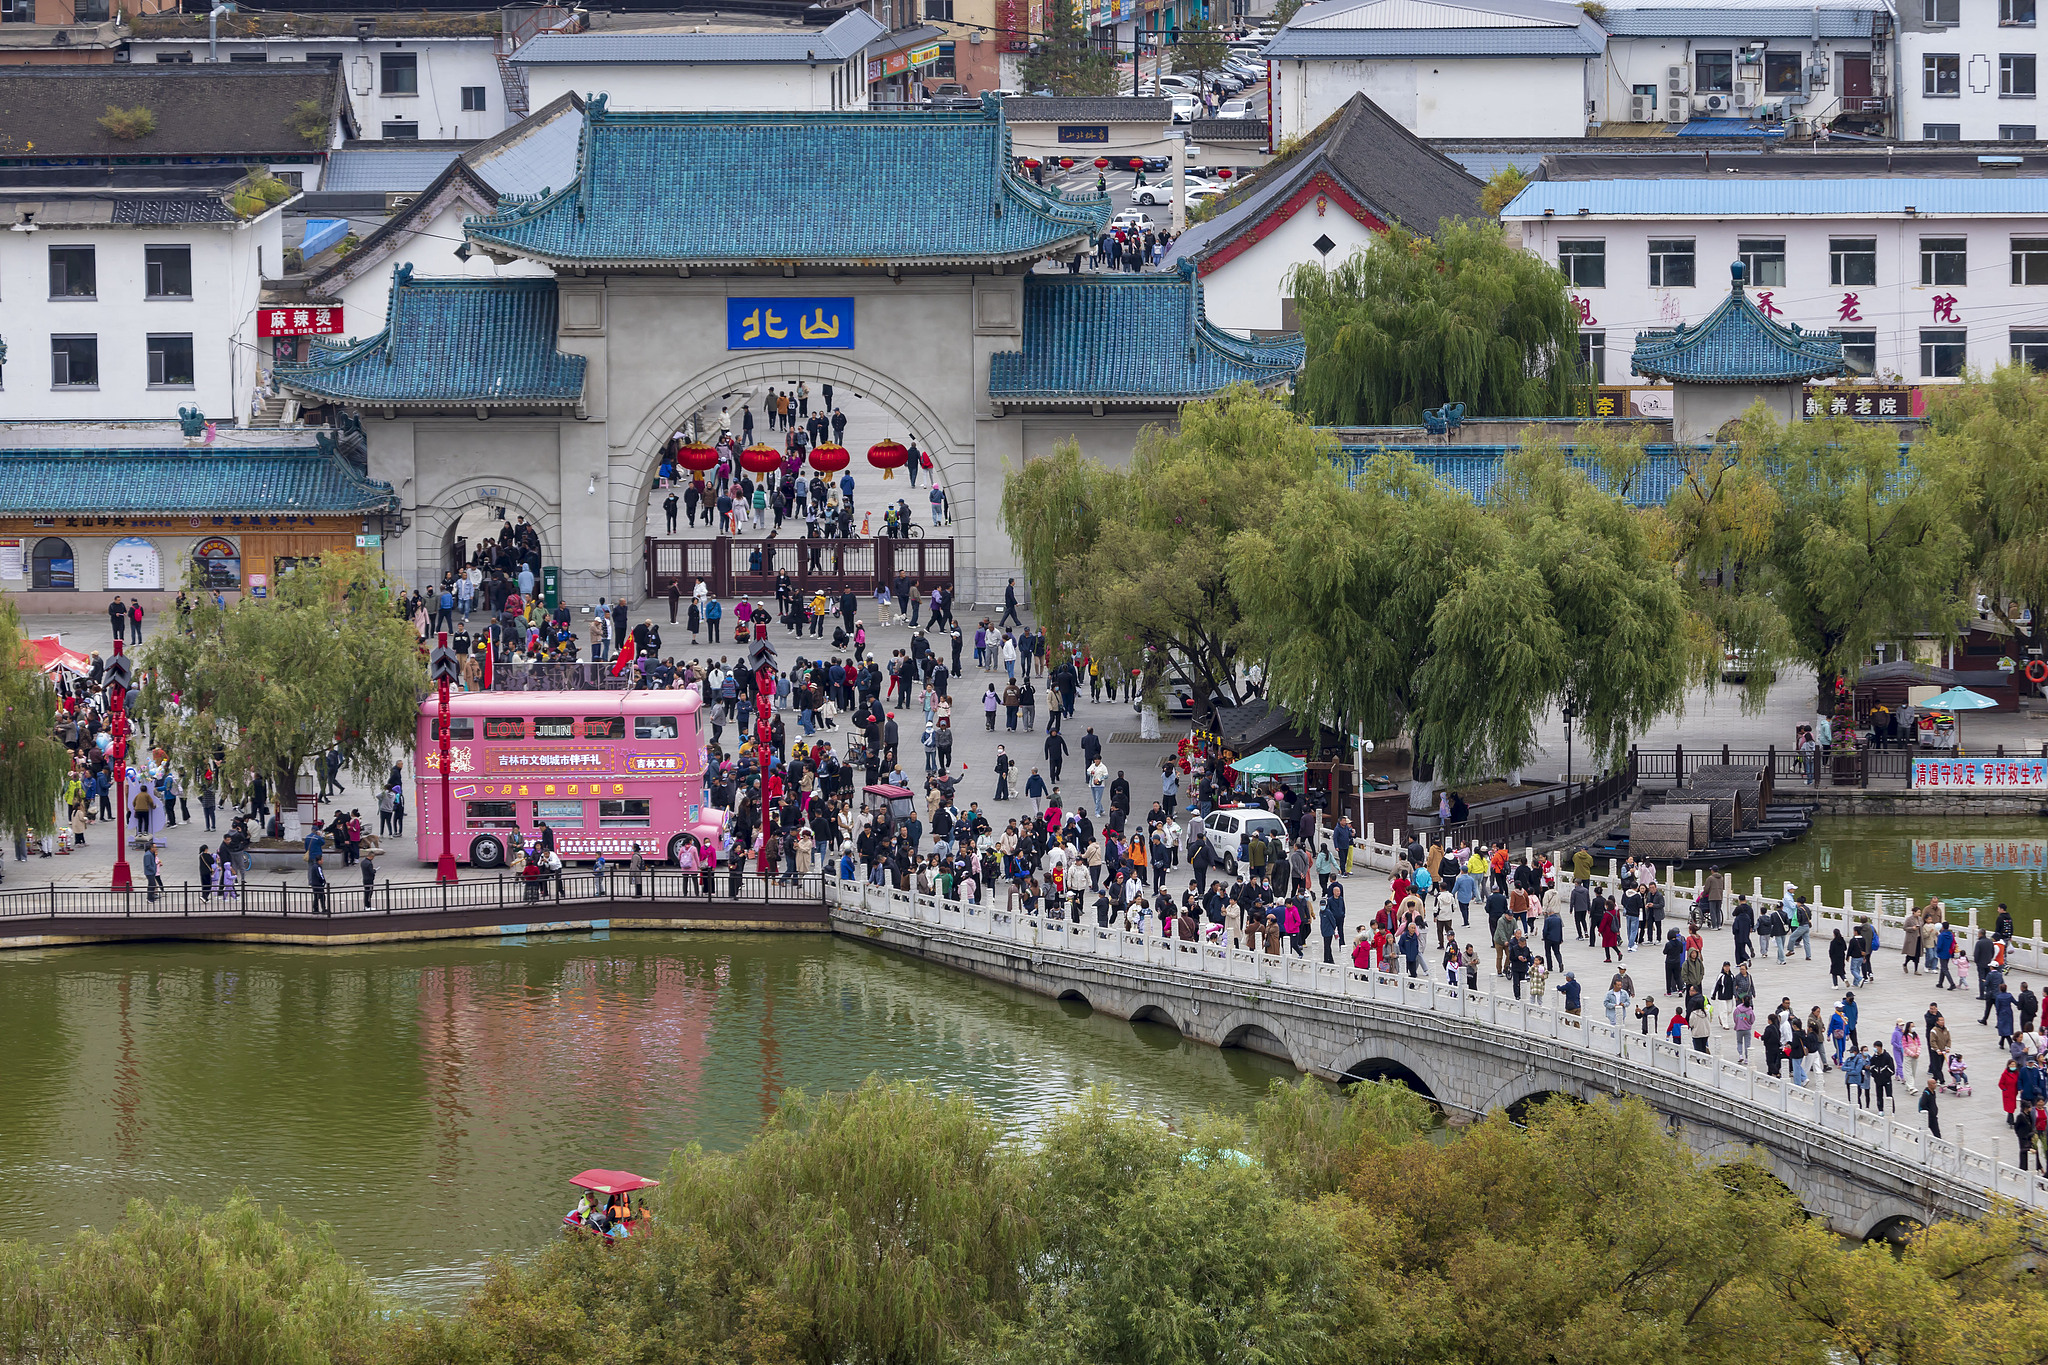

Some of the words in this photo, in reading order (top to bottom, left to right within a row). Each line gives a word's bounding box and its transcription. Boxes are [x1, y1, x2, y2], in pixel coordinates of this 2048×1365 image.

[271, 308, 332, 328] 麻辣烫
[742, 307, 840, 341] 北山
[480, 487, 497, 497] 入口
[486, 721, 536, 737] LOVE
[535, 724, 571, 736] JILIN
[570, 720, 613, 736] CITY
[498, 753, 601, 767] 吉林市文创城市伴手礼
[636, 758, 676, 769] 吉林文旅
[1915, 762, 1976, 786] 请遵守规定
[1983, 762, 2043, 786] 穿好救生衣
